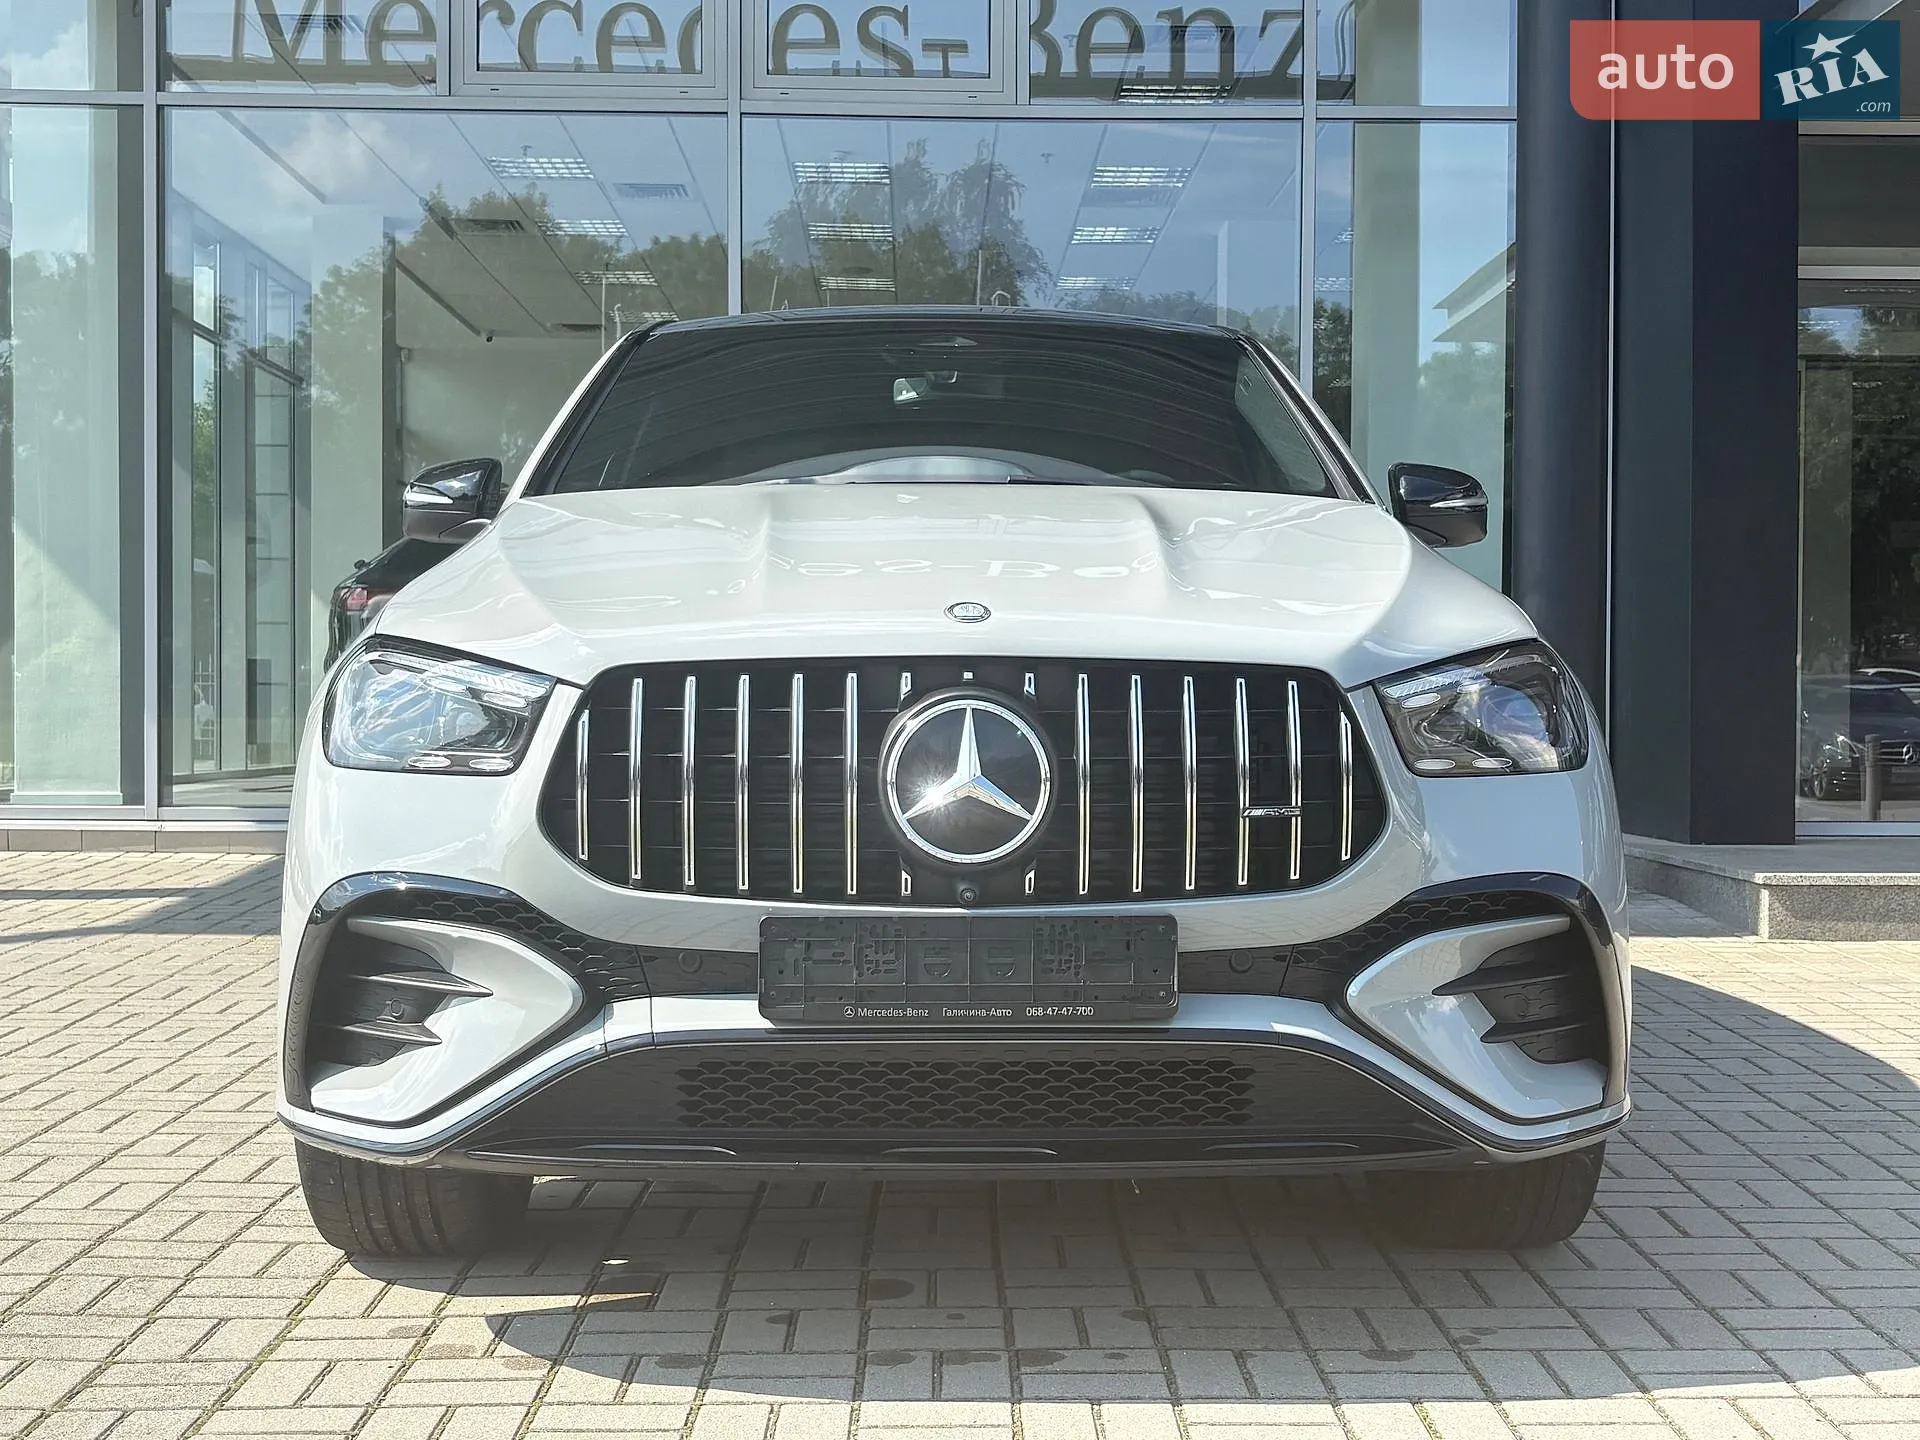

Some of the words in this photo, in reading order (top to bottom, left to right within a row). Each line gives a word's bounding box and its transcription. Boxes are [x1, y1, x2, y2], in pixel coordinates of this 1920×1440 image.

[857, 1007, 929, 1018] Mercedes-Benz
[942, 1007, 1013, 1018] Галичина-Авто
[1025, 1006, 1094, 1017] 068-47-47-700
